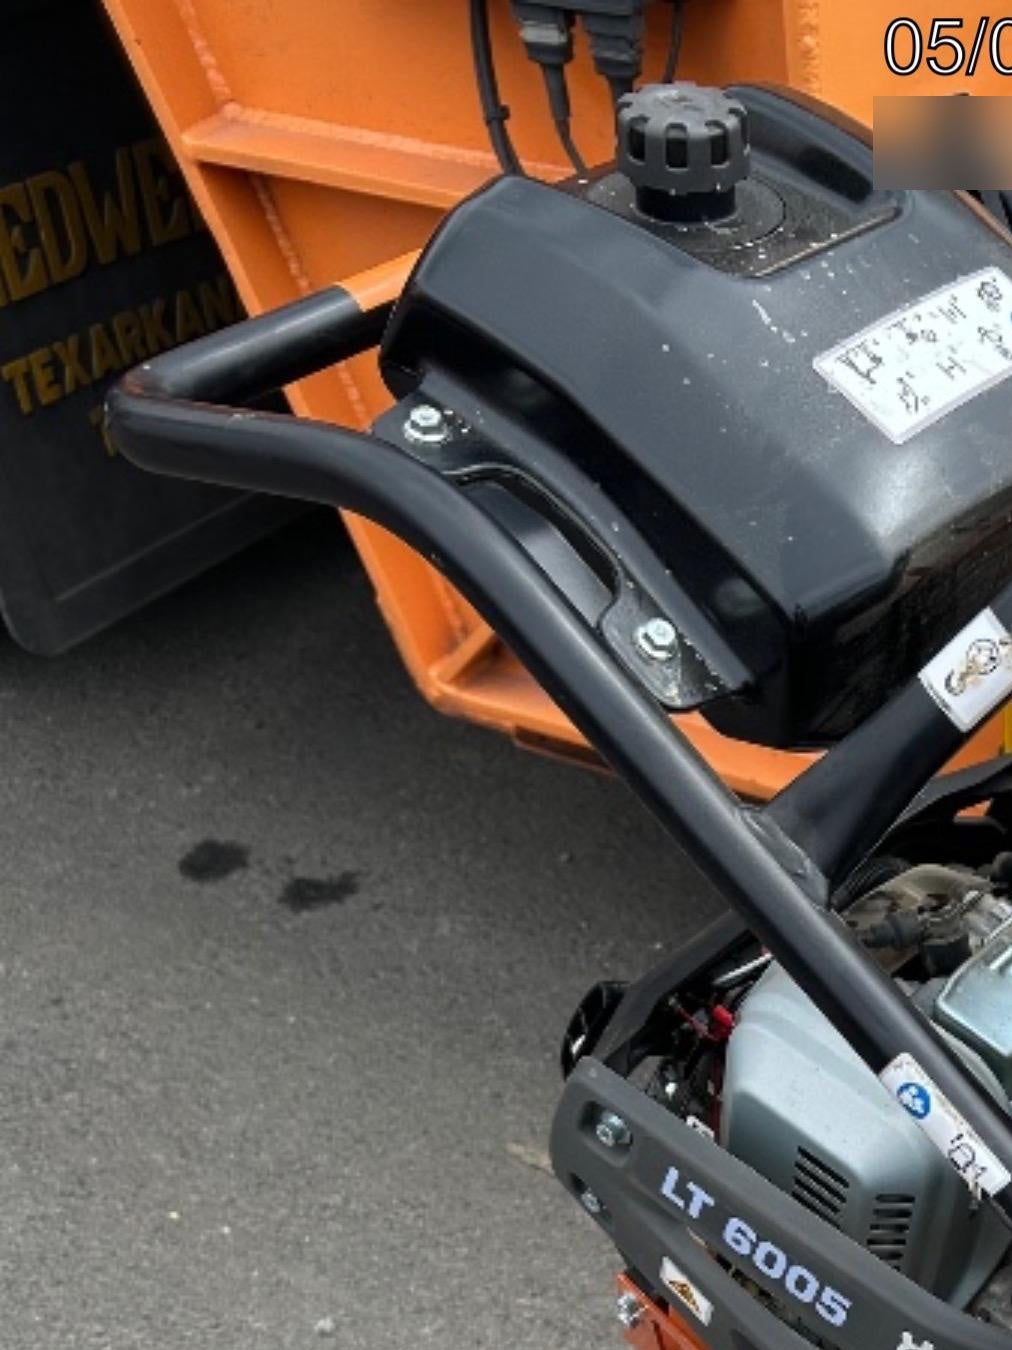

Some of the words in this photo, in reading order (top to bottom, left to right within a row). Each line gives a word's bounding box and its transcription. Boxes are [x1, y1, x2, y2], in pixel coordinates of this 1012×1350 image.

[0, 138, 208, 307] EDWE
[1, 278, 245, 415] TEXARKAN
[661, 1166, 715, 1219] LT
[722, 1217, 852, 1328] 6005
